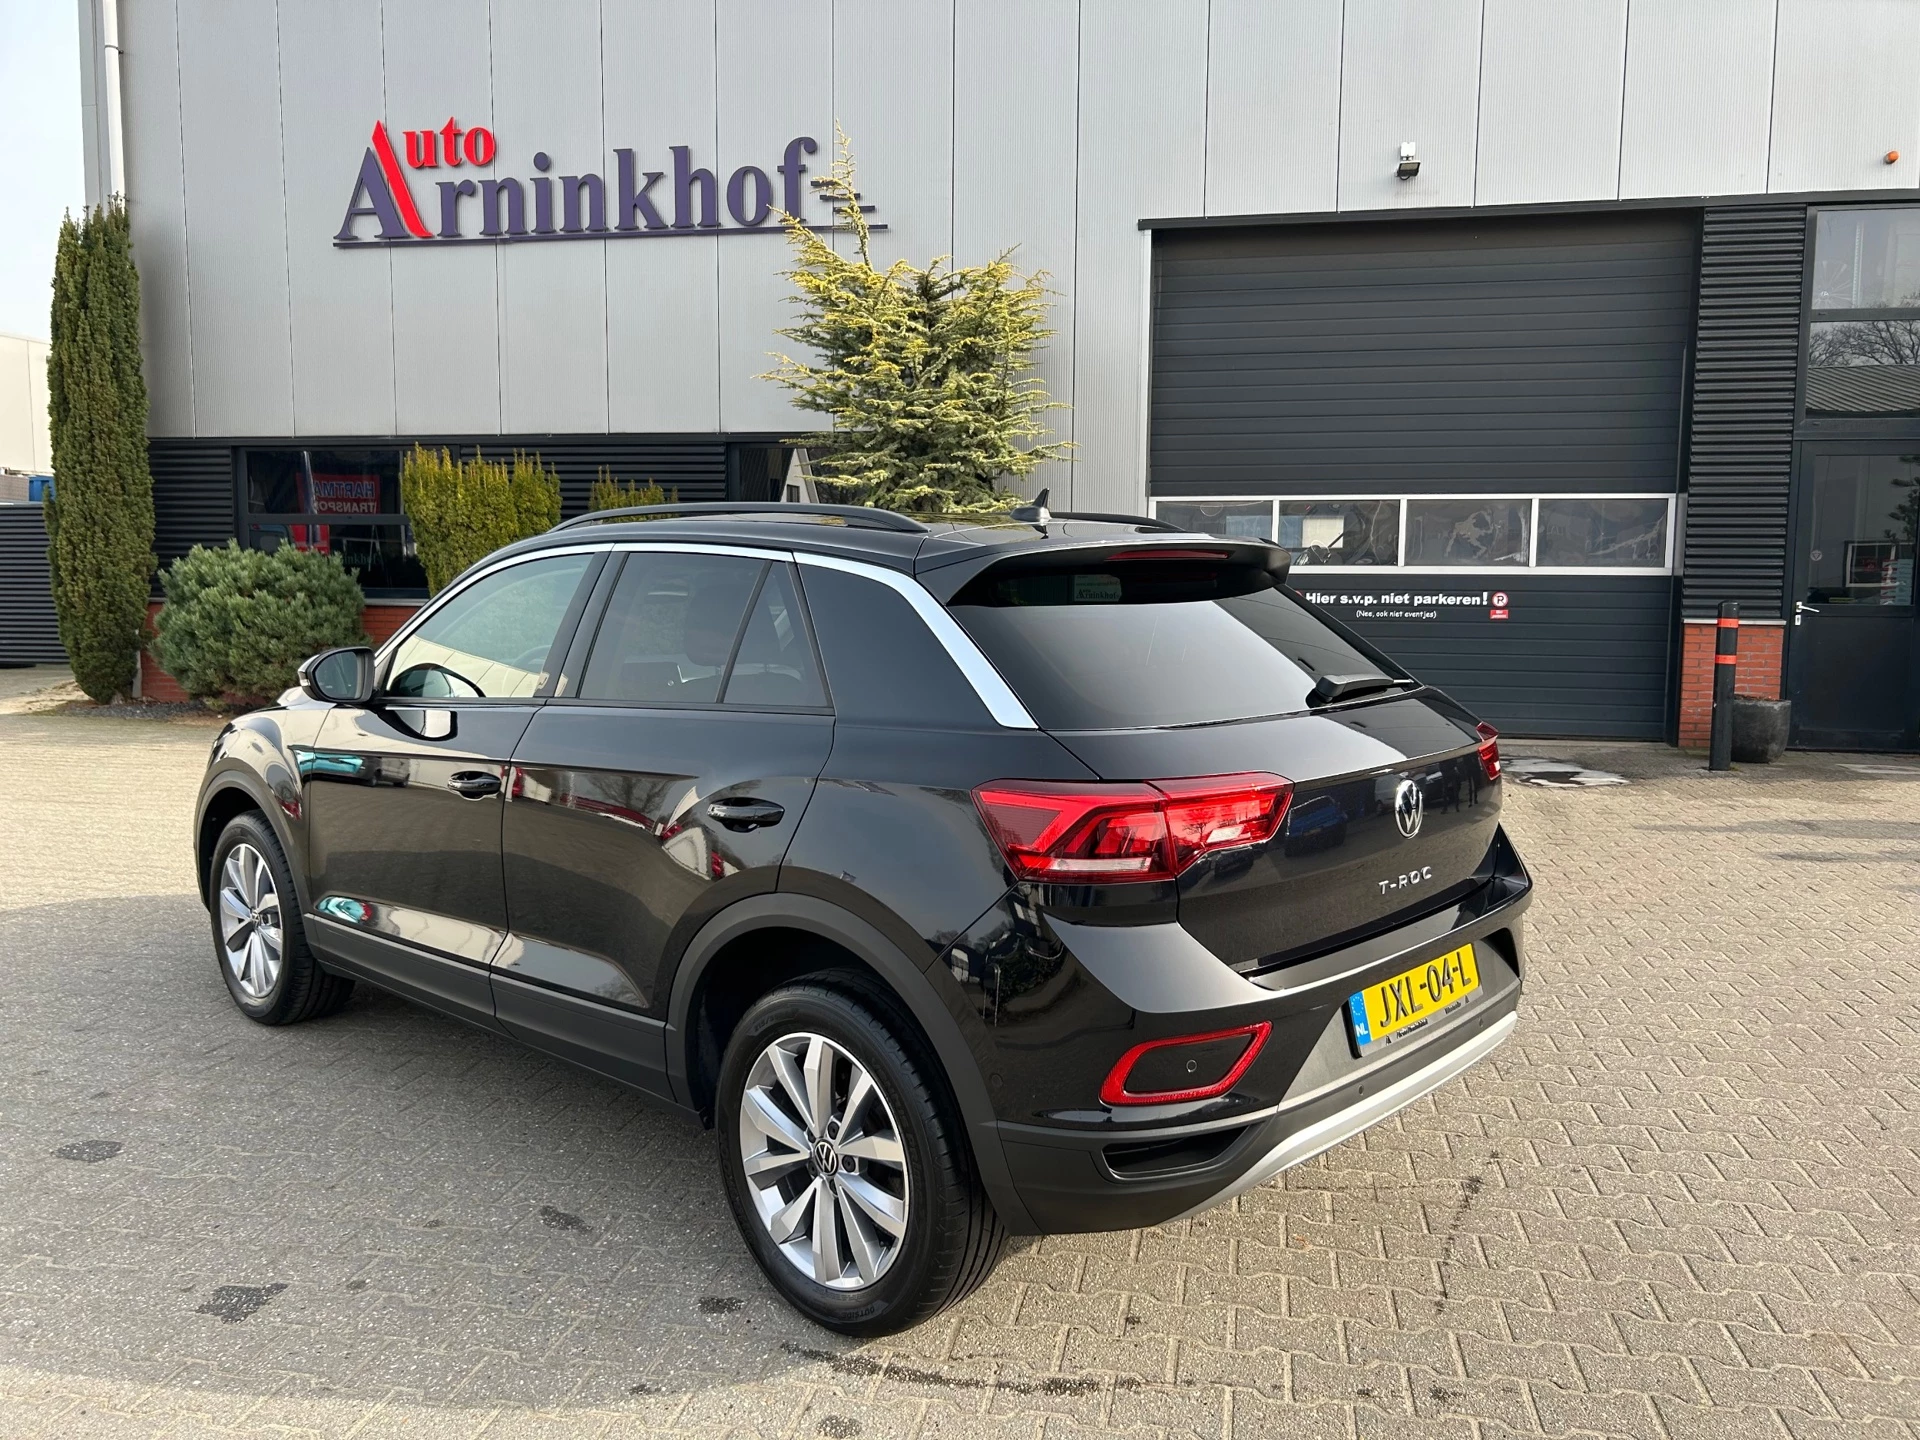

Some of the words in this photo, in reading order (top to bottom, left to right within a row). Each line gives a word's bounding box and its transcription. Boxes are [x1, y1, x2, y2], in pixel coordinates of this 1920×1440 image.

[332, 135, 818, 240] Arninkhof
[1305, 592, 1337, 604] Hier
[1340, 594, 1377, 607] s.v.p.
[1381, 592, 1410, 604] niet
[1413, 591, 1488, 607] parkeren!
[1389, 609, 1403, 618] niet
[1404, 609, 1437, 619] eventjes)
[1378, 866, 1432, 895] T-ROC
[1379, 951, 1472, 1028] JXL-04-L
[1355, 1024, 1369, 1038] NL
